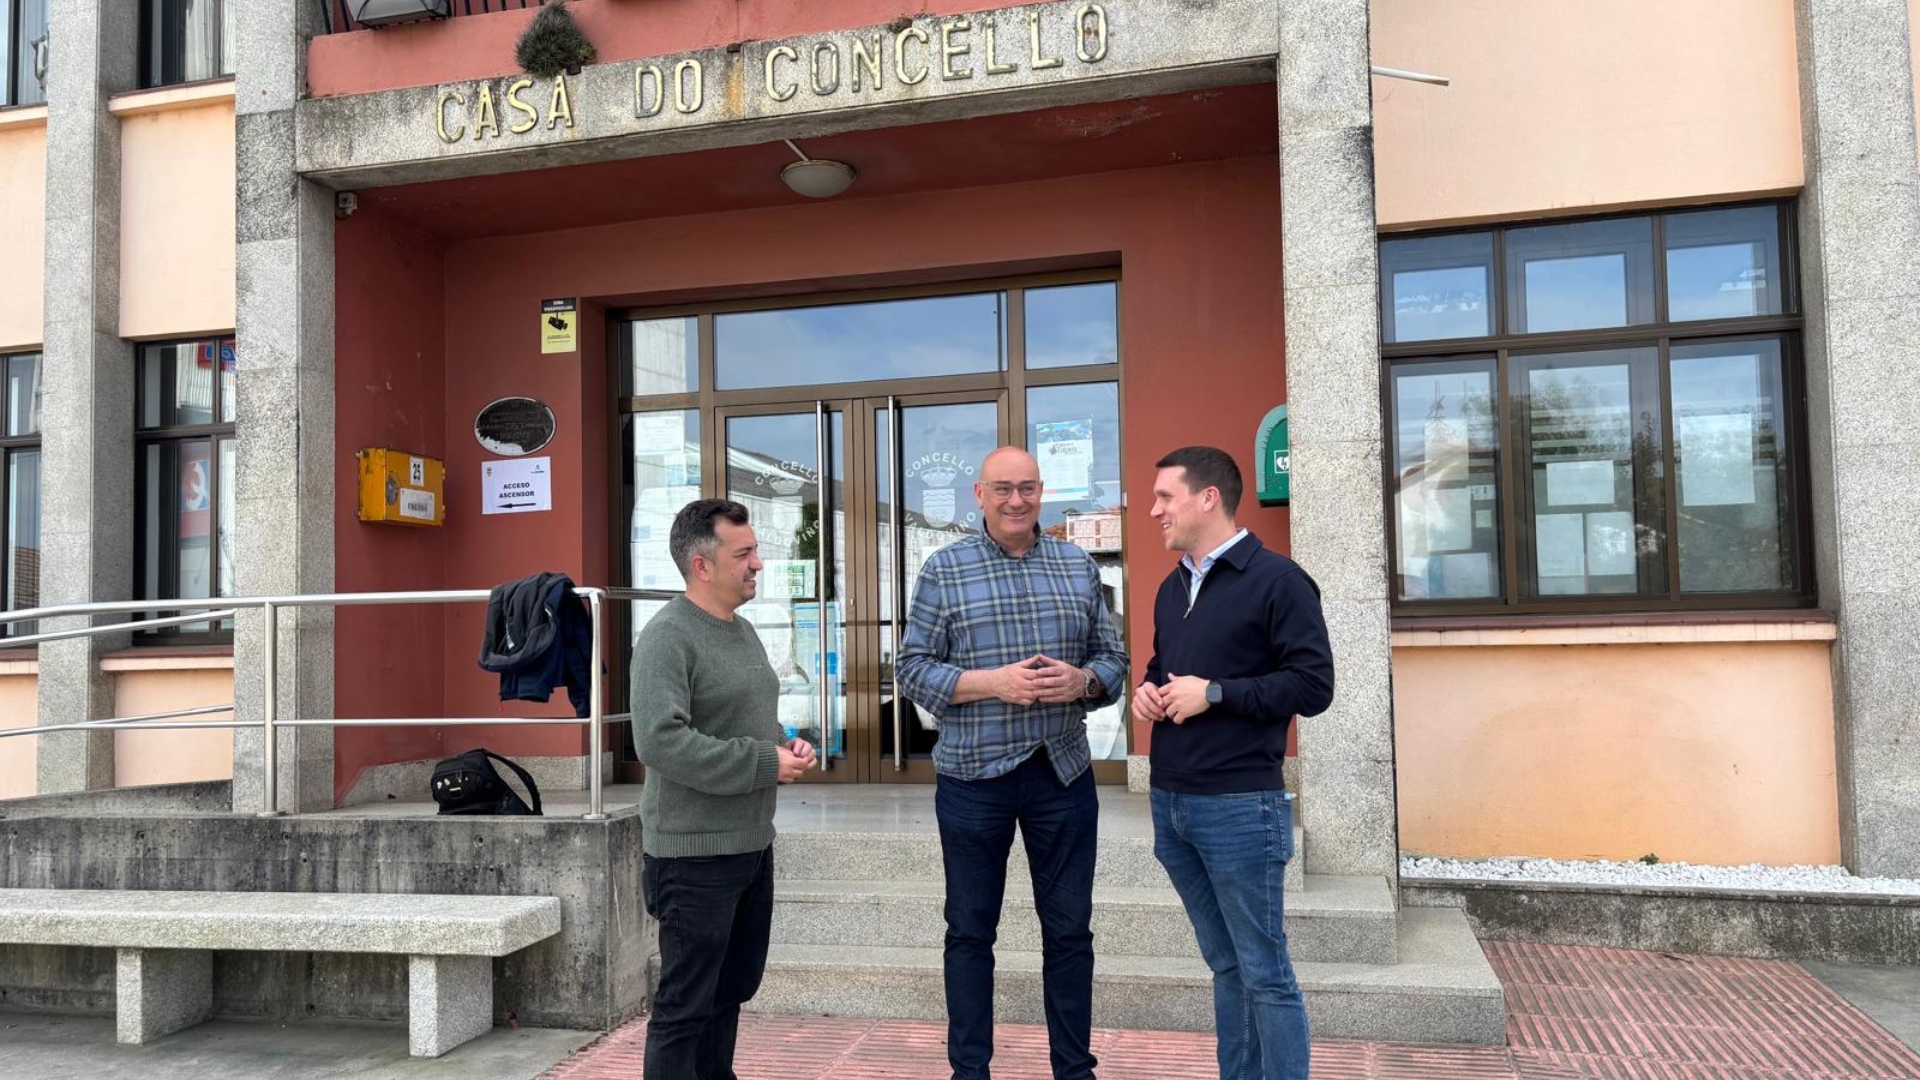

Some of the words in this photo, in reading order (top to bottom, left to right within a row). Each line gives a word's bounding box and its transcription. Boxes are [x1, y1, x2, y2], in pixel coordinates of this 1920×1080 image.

[437, 75, 574, 143] CASA
[634, 58, 703, 119] DO
[764, 4, 1107, 101] CONCELLO
[412, 463, 421, 480] 25
[905, 452, 974, 478] CONCELLO
[503, 482, 530, 490] ACCESO
[499, 491, 535, 499] ASCENSOR
